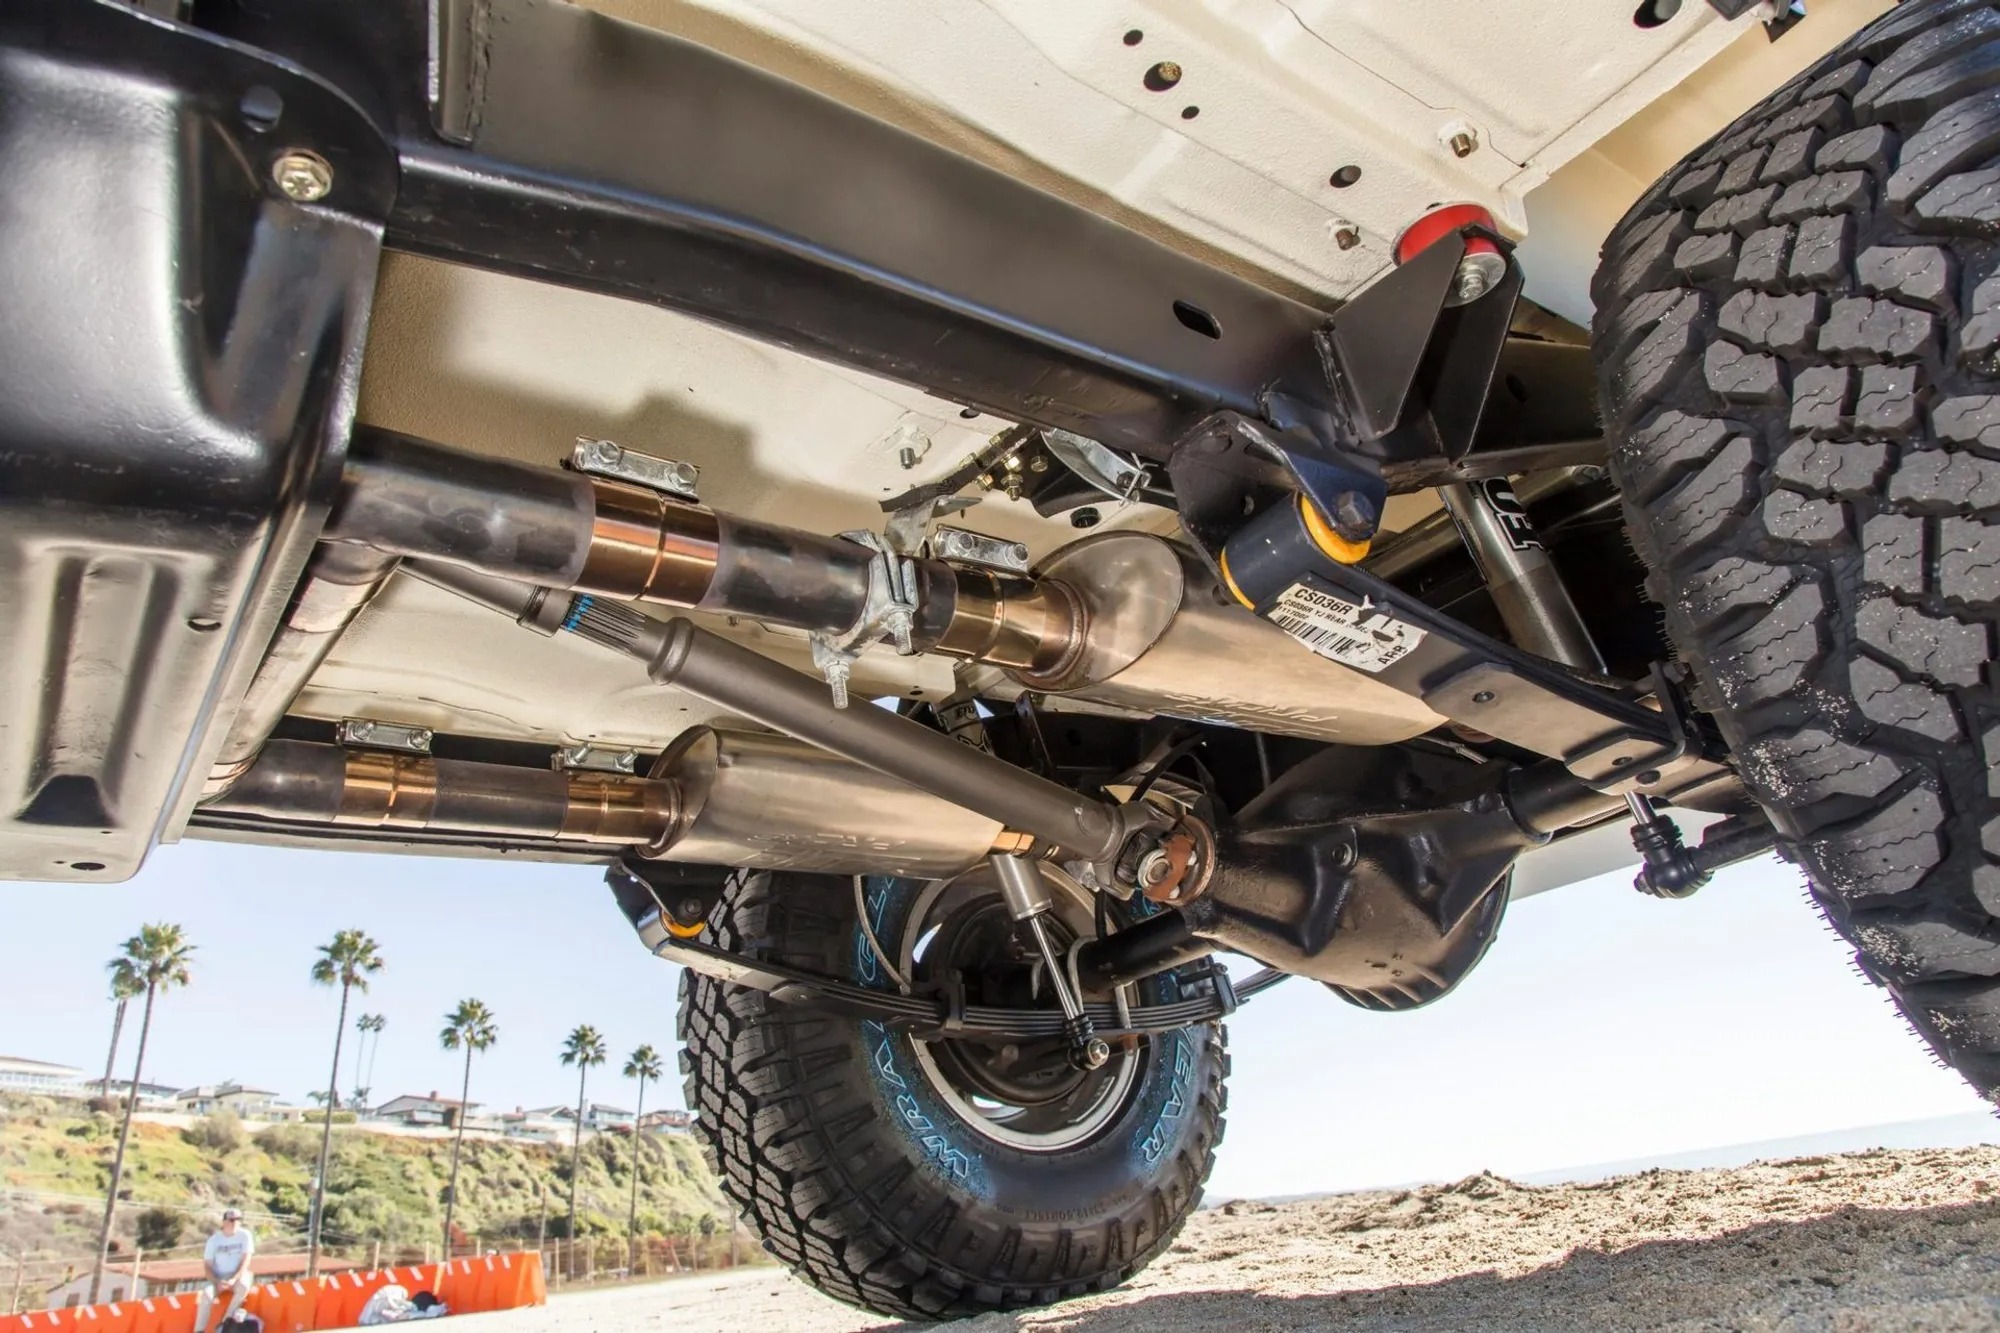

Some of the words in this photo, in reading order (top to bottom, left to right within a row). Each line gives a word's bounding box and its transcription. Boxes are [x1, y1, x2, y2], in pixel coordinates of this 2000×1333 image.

[1284, 599, 1313, 613] CS036R
[1324, 613, 1347, 625] REAR
[1294, 588, 1353, 615] CS036R
